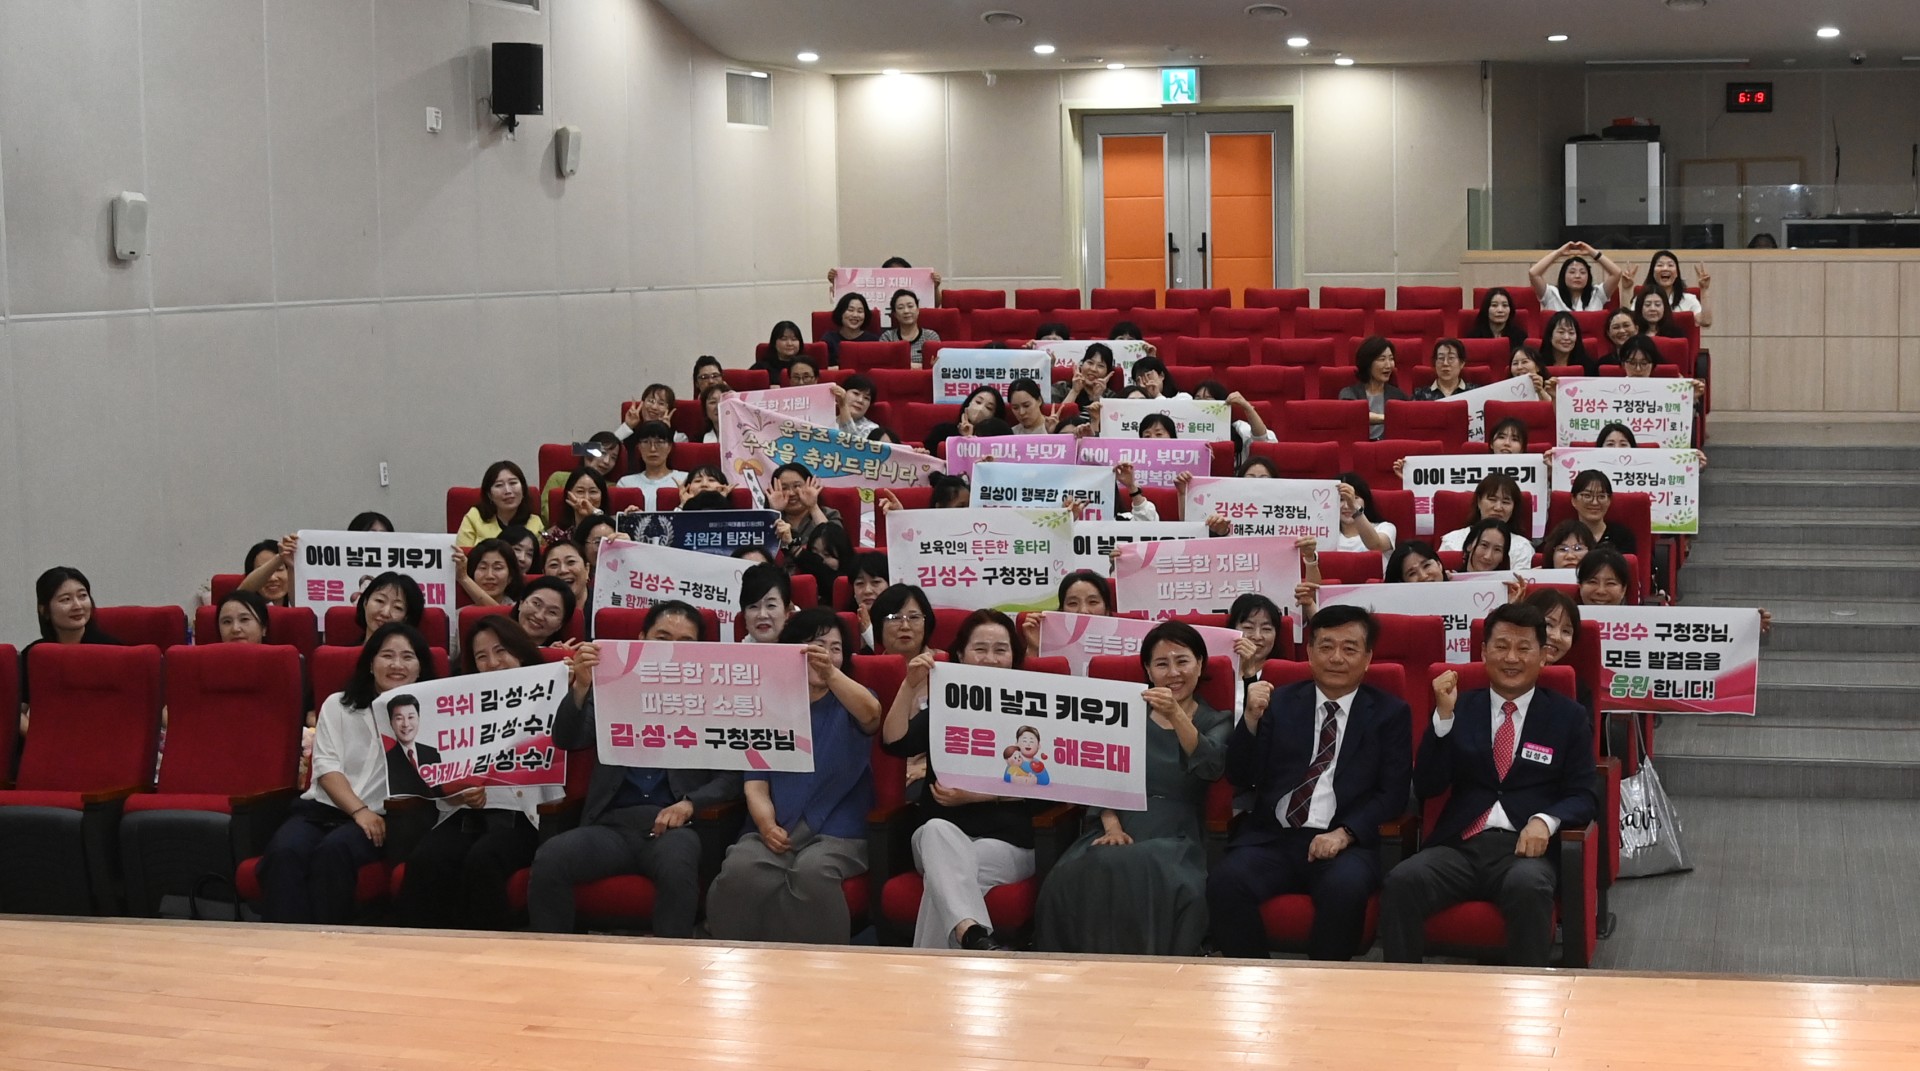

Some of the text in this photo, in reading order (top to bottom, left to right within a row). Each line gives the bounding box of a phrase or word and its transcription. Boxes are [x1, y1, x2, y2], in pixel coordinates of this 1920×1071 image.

[1738, 92, 1765, 103] 6:19
[941, 367, 972, 379] 일상이
[975, 368, 1007, 380] 행복한
[783, 396, 810, 411] 지원!
[1572, 398, 1681, 413] 김성수 구청장님과 함께
[1188, 422, 1215, 433] 울타리
[1569, 418, 1600, 431] 해운대
[779, 420, 885, 453] 윤금조 원장님
[743, 430, 919, 486] 수상을 축하드립니다
[990, 443, 1022, 461] 교사,
[1026, 443, 1067, 459] 부모가
[1080, 447, 1201, 467] 아이, 교사, 부모가
[1134, 469, 1177, 487] 행복한
[1413, 467, 1445, 485] 아이
[1450, 467, 1482, 484] 낳고
[1611, 472, 1686, 486] 구청장님과 함께
[980, 486, 1017, 502] 일상이
[1021, 487, 1059, 502] 행복한
[1215, 502, 1311, 520] 김성수 구청장님,
[683, 531, 765, 546] 최원겸 팀장님
[1278, 524, 1330, 538] 감사합니다
[306, 545, 442, 569] 아이 낳고 키우기
[919, 539, 1051, 555] 보육인의 든든한 울타리
[1155, 553, 1260, 575] 든든한 지원!
[917, 565, 1049, 587] 김성수 구청장님
[306, 579, 345, 602] 좋은
[629, 570, 731, 605] 김성수 구청장님,
[1157, 581, 1214, 601] 따뜻한
[611, 592, 622, 606] 늘
[1599, 622, 1734, 643] 김성수 구청장님,
[1605, 650, 1721, 671] 모든 발걸음을
[639, 661, 760, 686] 든든한 지원!
[1611, 675, 1714, 699] 응원 합니다!
[436, 693, 474, 717] 역쉬
[641, 692, 763, 717] 따뜻한 소통!
[945, 682, 1129, 728] 아이 낳고 키우기
[437, 726, 474, 752] 다시
[610, 723, 796, 751] 김·성·수 구청장님
[945, 725, 1131, 774] 좋은 해운대
[419, 760, 471, 785] 언제나
